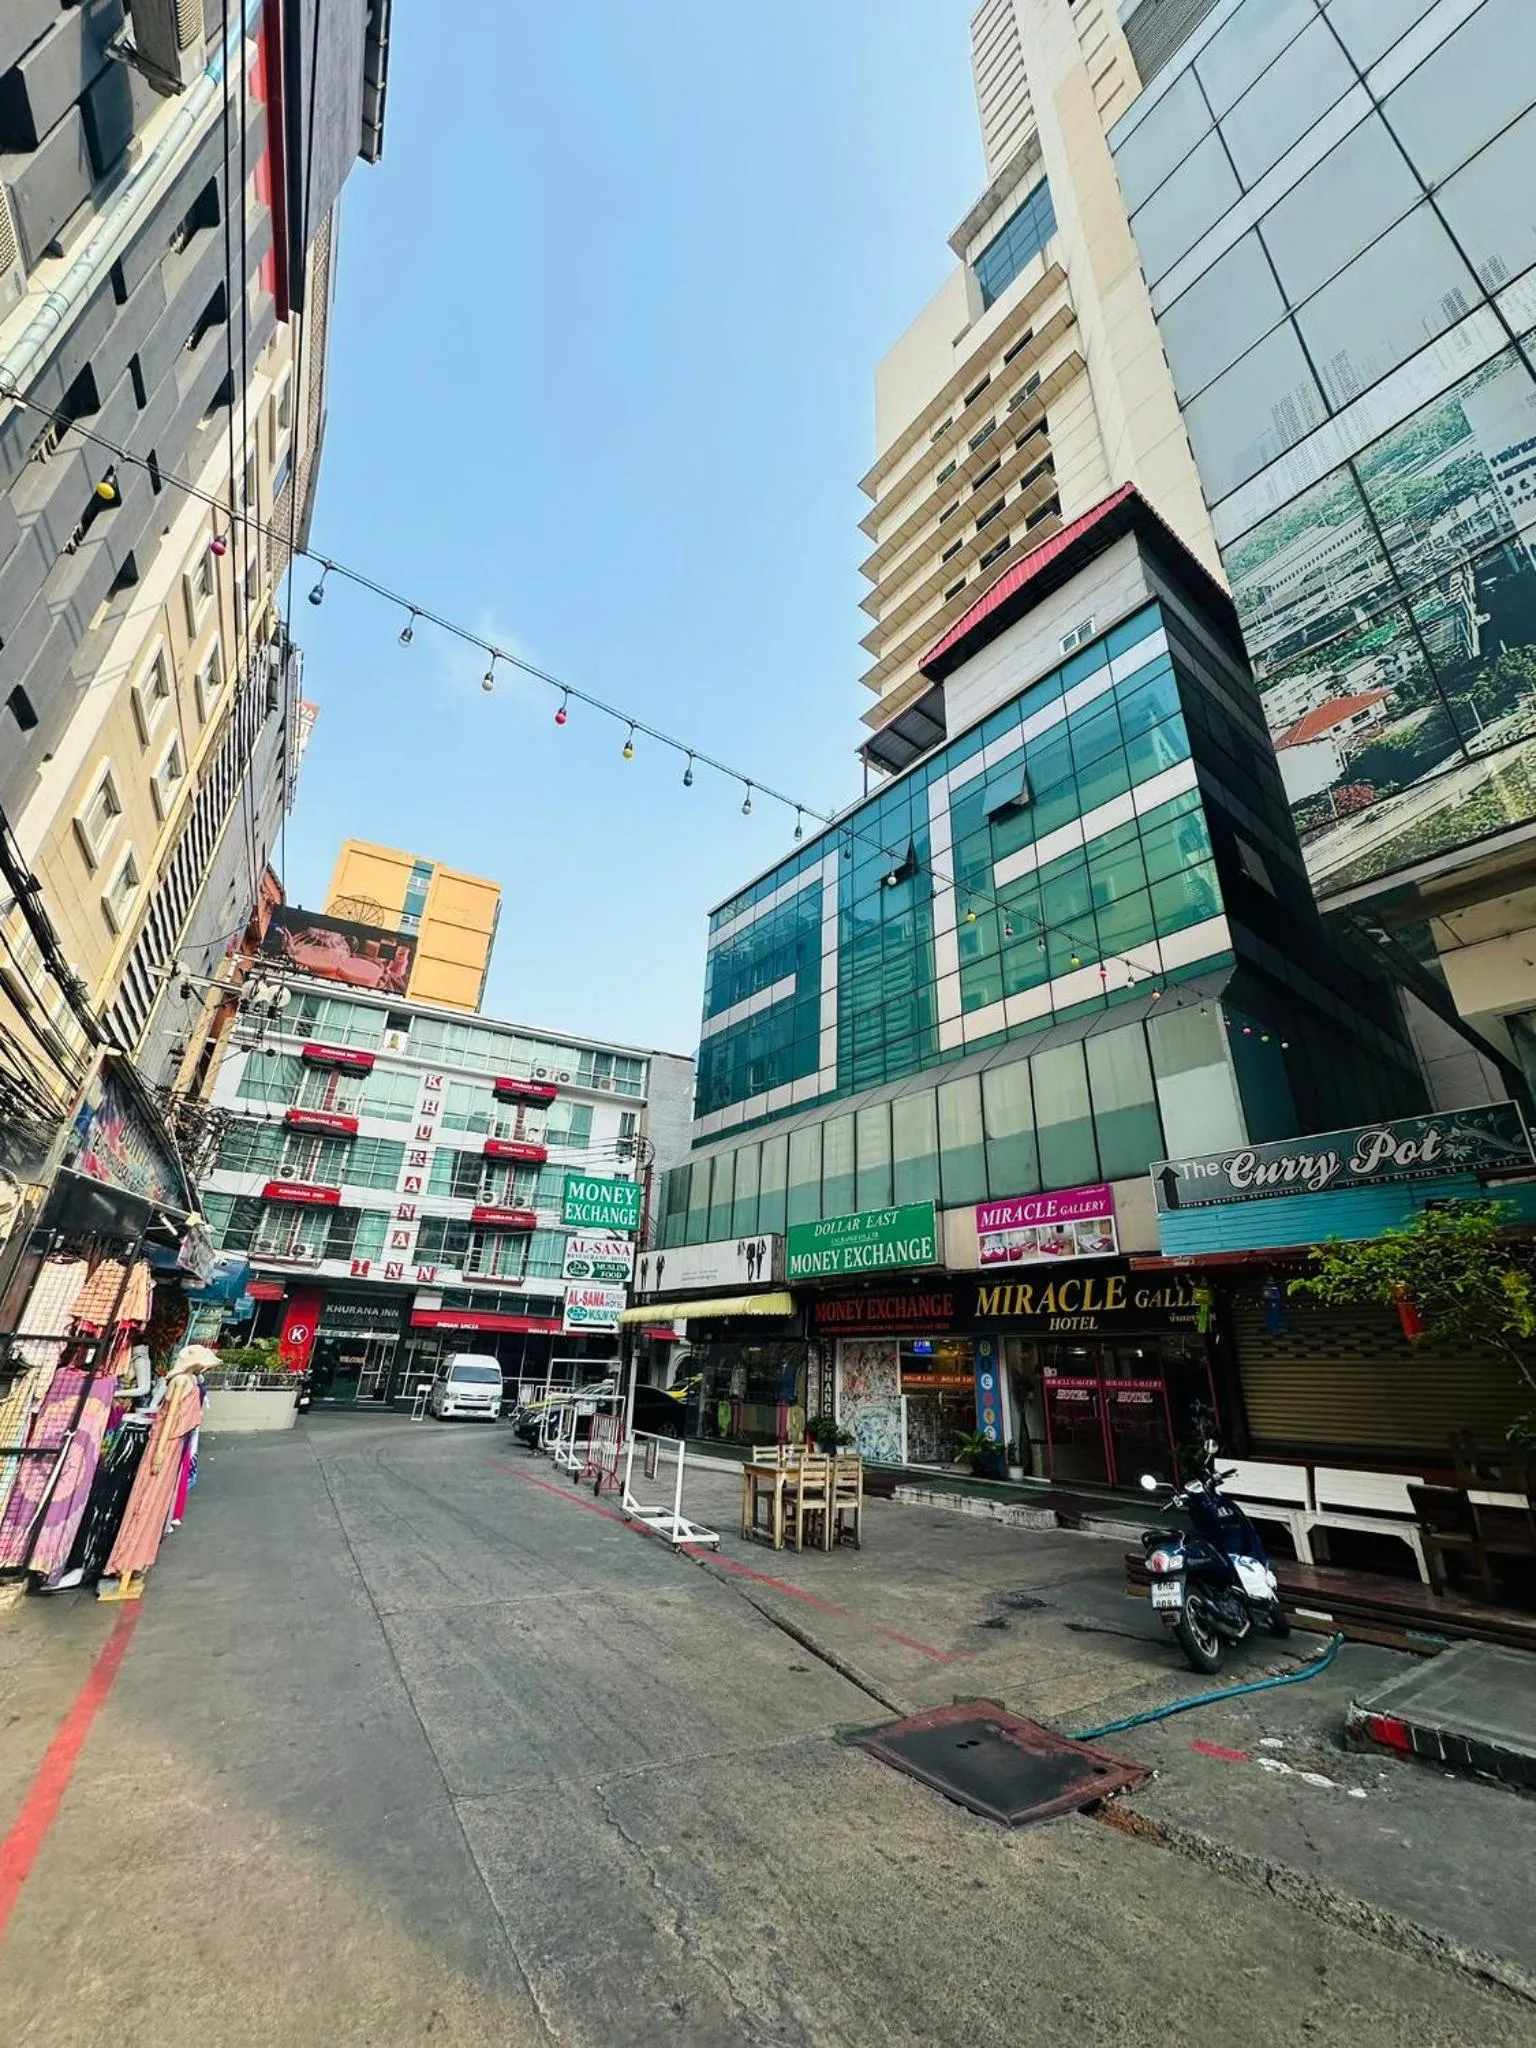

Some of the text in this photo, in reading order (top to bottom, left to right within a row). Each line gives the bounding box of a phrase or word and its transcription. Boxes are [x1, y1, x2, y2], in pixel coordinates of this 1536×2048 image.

[1180, 1160, 1220, 1180] The
[1222, 1150, 1341, 1191] Curry
[1349, 1127, 1442, 1174] Pot
[568, 1181, 637, 1206] MONEY
[565, 1202, 637, 1226] EXCHANGE
[814, 1210, 899, 1237] DOLLAR EAST
[981, 1200, 1107, 1228] MIRACLE GALLERY
[568, 1241, 631, 1257] AL-SANA
[790, 1236, 932, 1274] MONEY EXCHANGE
[596, 1262, 627, 1272] MUSLIM
[600, 1270, 622, 1279] FOOD
[567, 1289, 606, 1308] AL-SANA
[815, 1292, 955, 1322] MONEY EXCHANGE
[974, 1276, 1127, 1317] MIRACLE
[326, 1304, 399, 1317] KHURANA INN
[1050, 1316, 1099, 1332] HOTEL
[1056, 1389, 1090, 1400] HOTEL
[1117, 1391, 1154, 1404] HOTEL
